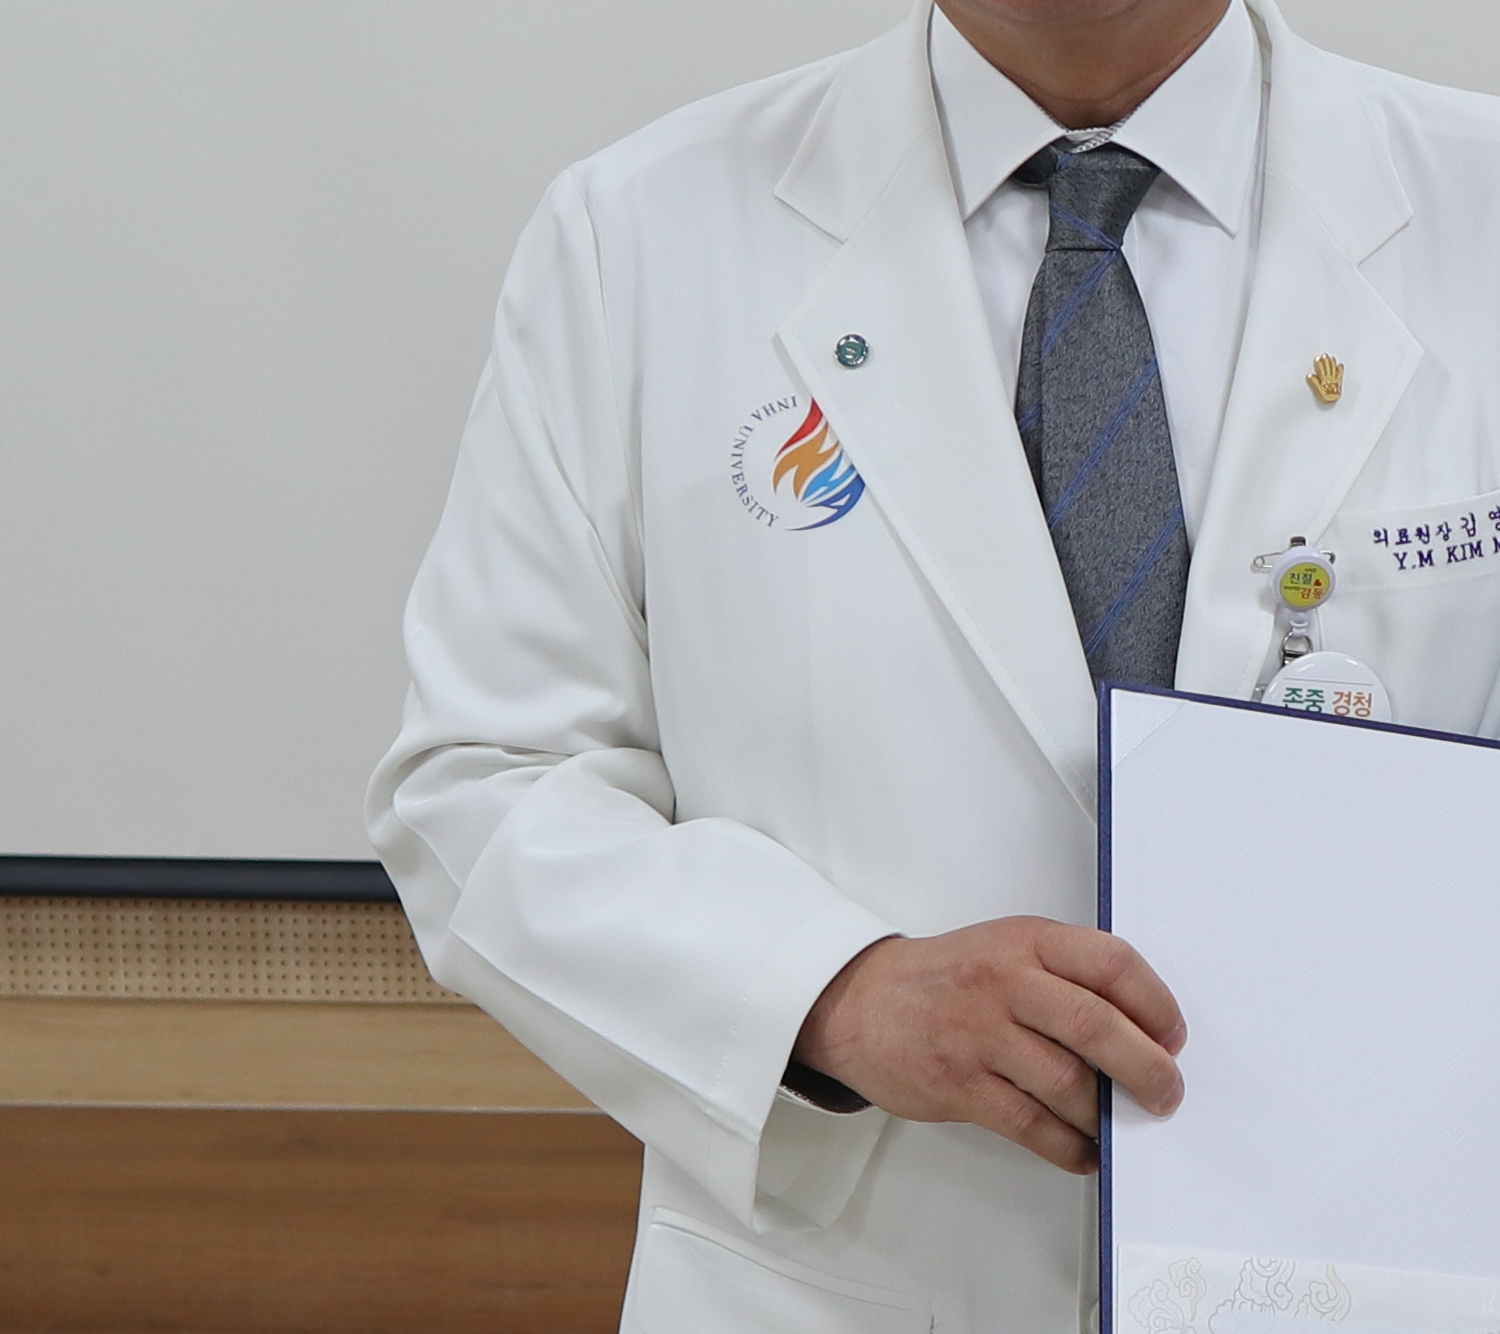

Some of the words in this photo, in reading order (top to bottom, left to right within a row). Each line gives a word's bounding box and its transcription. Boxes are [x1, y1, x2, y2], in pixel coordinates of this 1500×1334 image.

[751, 395, 797, 422] INHA
[730, 425, 779, 528] UNIVERSITY
[1394, 549, 1434, 570] Y.M
[1446, 540, 1484, 564] KIM
[1332, 691, 1373, 717] 경청
